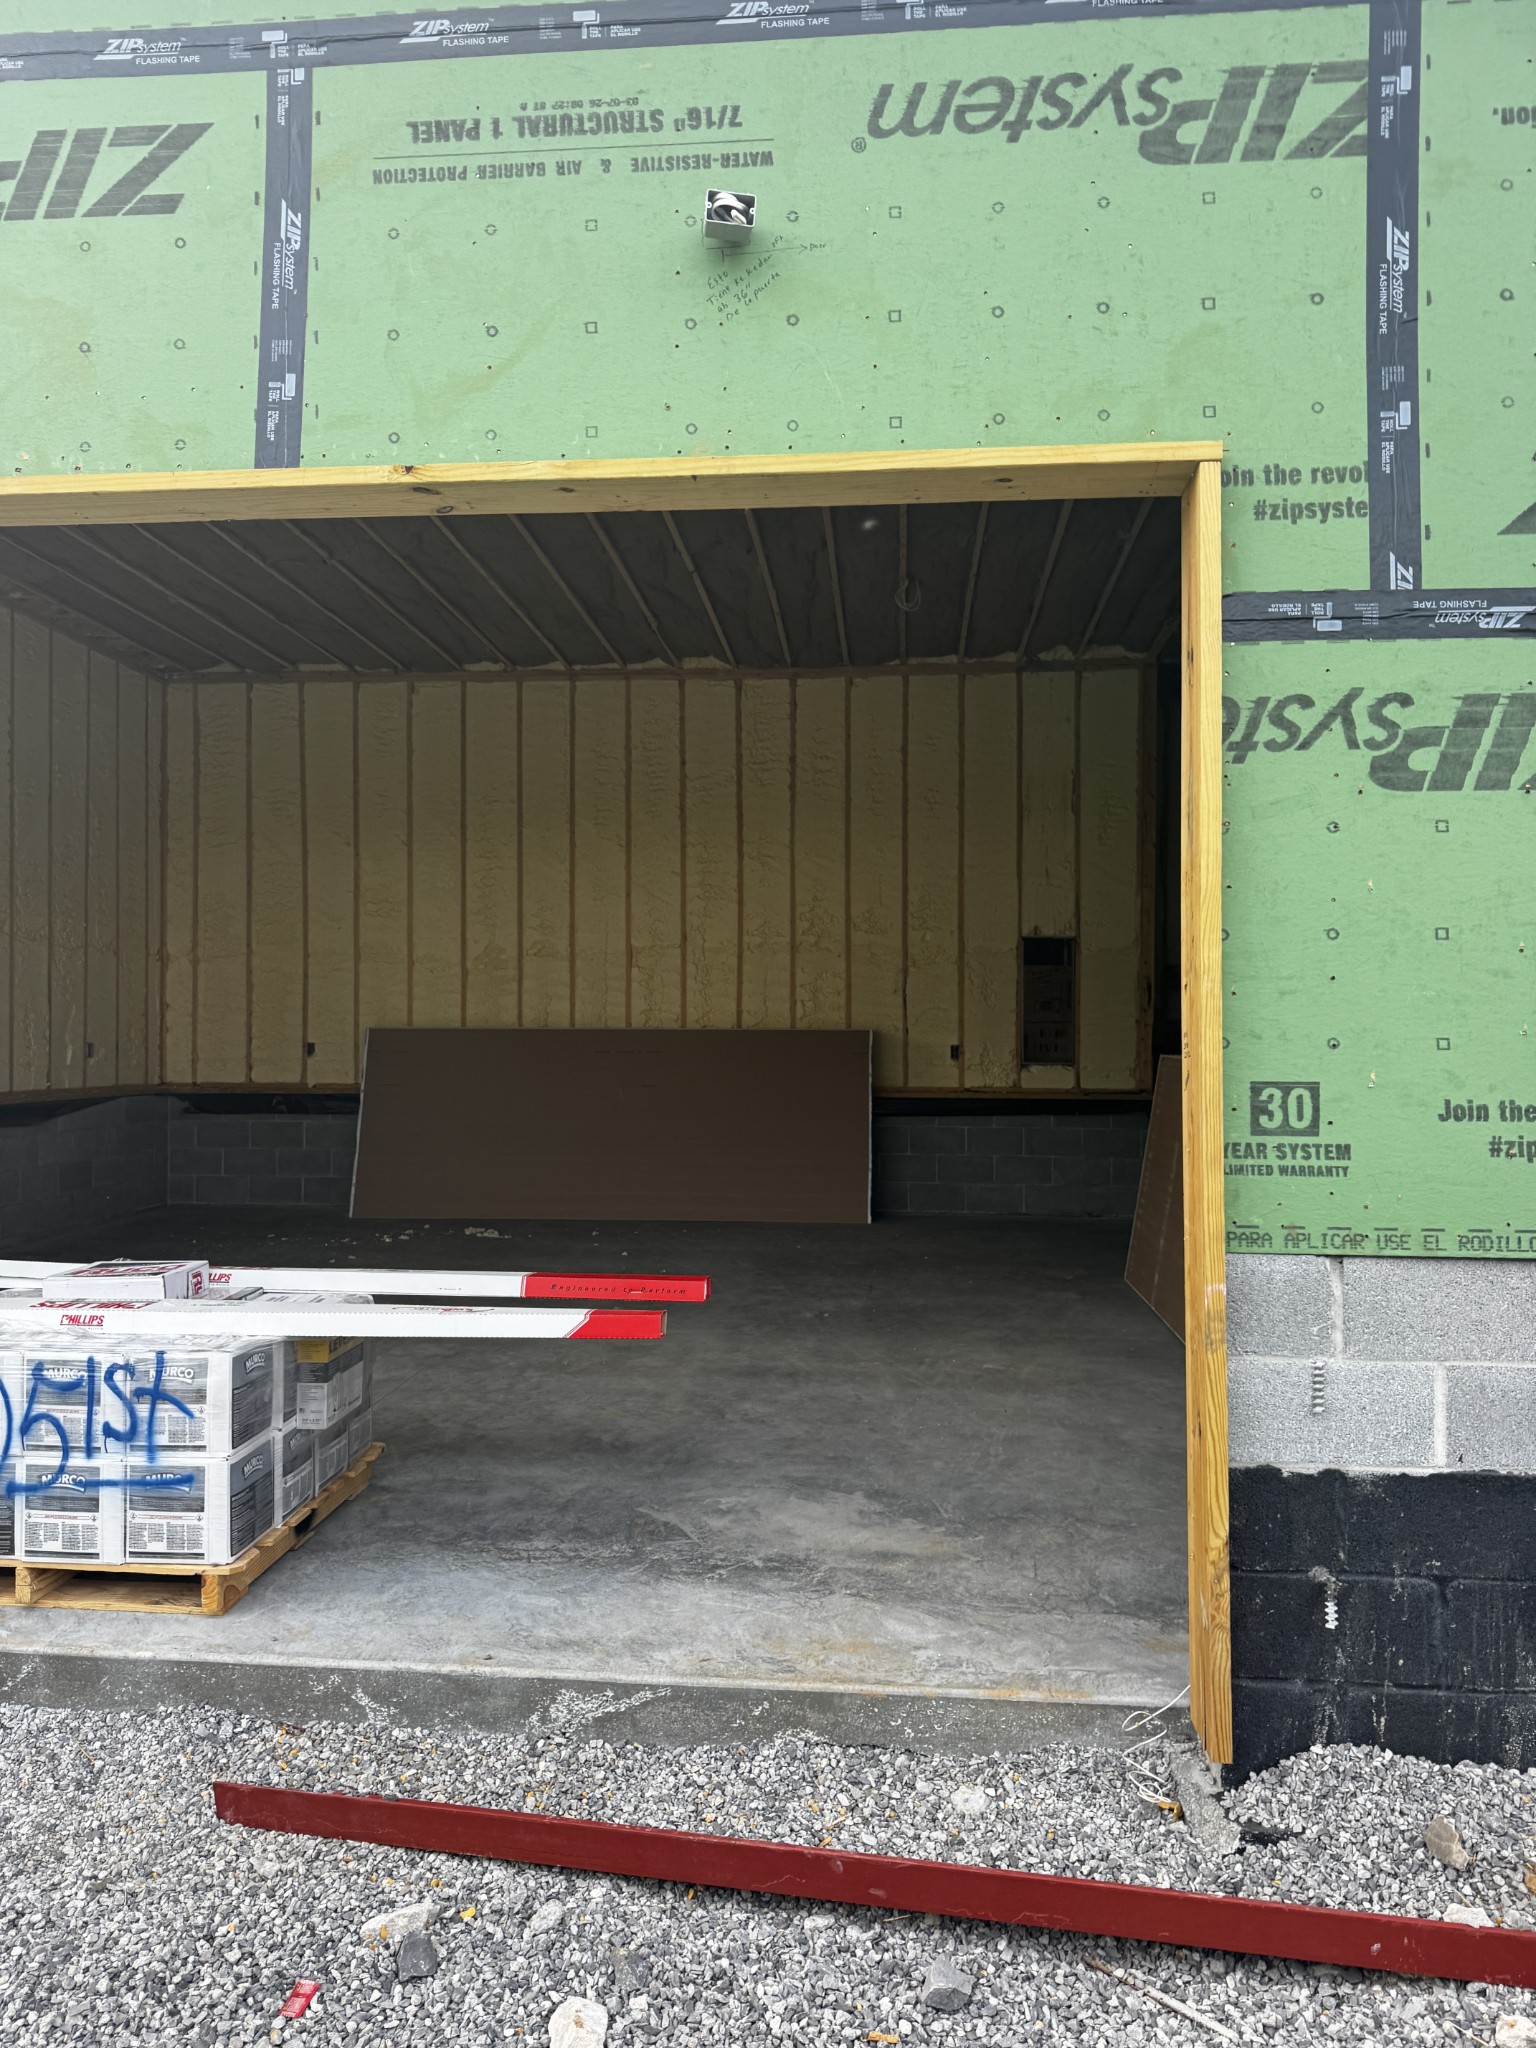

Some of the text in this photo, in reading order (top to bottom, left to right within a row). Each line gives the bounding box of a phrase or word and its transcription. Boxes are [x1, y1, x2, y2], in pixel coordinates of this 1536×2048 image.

[760, 17, 830, 29] FLASHING TAPE
[443, 37, 485, 46] FLASHING
[136, 55, 200, 65] FLASHING TAPE
[406, 118, 481, 144] PANEL
[490, 117, 503, 140] 1
[512, 108, 664, 138] STRUCTURAL
[373, 151, 774, 184] WATER-RESISTIVE & AIR BARRIER PROTECTION
[272, 243, 281, 309] FLASHING TAPE
[1263, 463, 1302, 486] the
[1397, 561, 1413, 590] ZI
[1440, 600, 1487, 608] FLASHING
[1259, 1087, 1313, 1129] 30
[1438, 1098, 1536, 1122] Join the
[1224, 1142, 1352, 1161] YEAR SYSTEM
[1224, 1164, 1349, 1178] LIMITED WARRANTY
[1226, 1231, 1273, 1248] PARA
[1284, 1232, 1366, 1250] APLICAR
[1376, 1234, 1411, 1250] USE
[1423, 1235, 1447, 1251] EL
[551, 1284, 616, 1292] Engineered
[60, 1314, 105, 1326] PHILLIPS
[245, 1352, 265, 1370] MURCO
[243, 1455, 263, 1473] MURCO
[41, 1474, 86, 1484] MRCO
